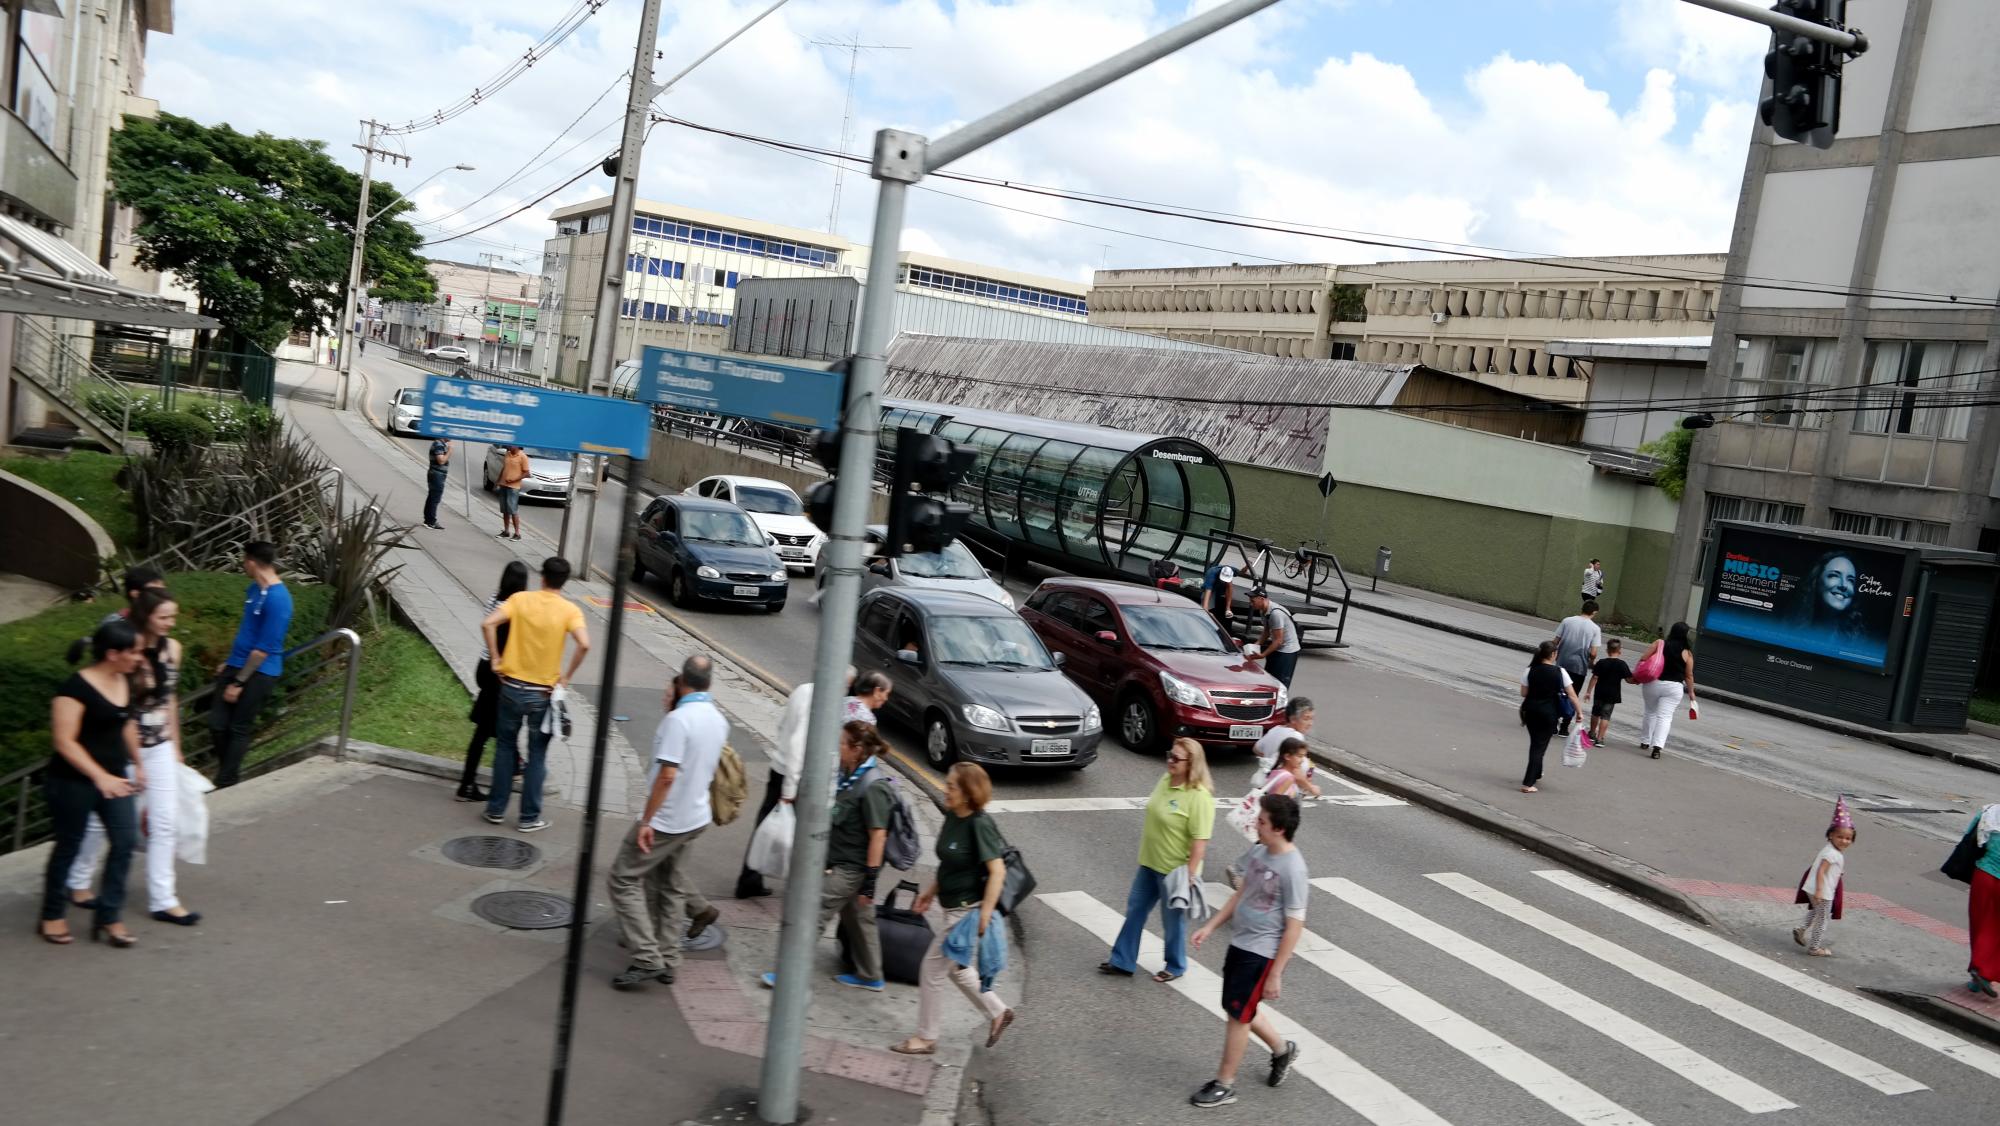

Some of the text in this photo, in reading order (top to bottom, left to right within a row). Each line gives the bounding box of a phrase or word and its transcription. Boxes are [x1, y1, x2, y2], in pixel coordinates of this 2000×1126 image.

[659, 352, 682, 368] Av.
[432, 380, 466, 398] Av.
[512, 391, 540, 407] de
[1152, 449, 1203, 464] Desembarque
[1723, 559, 1780, 581] MUSIC
[1721, 571, 1779, 589] experiment
[1858, 583, 1894, 597] Carolina
[1775, 657, 1813, 671] Clear Channel
